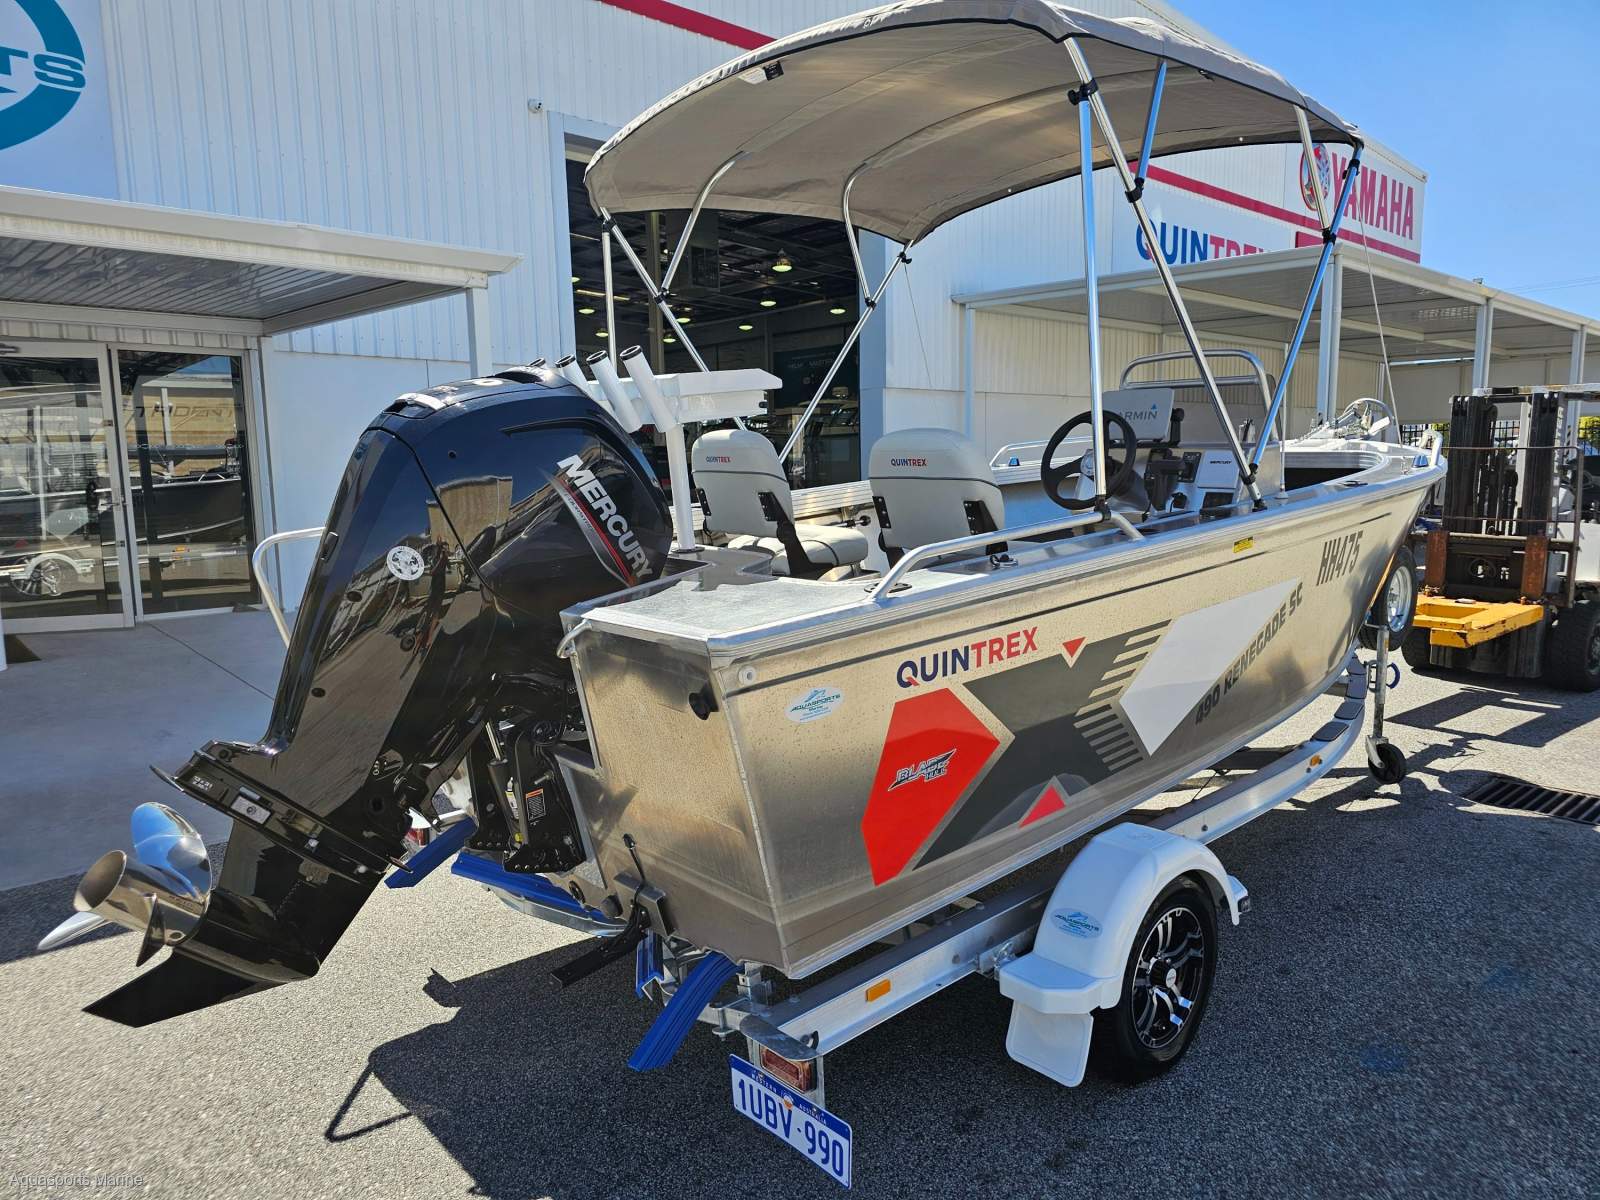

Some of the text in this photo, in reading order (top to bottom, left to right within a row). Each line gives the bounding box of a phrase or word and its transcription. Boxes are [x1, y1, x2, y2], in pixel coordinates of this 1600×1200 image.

[1332, 152, 1413, 240] YAMAHA
[890, 458, 927, 467] QUINTREX
[557, 454, 653, 578] MERCURY
[1316, 530, 1364, 586] HH475
[896, 626, 1038, 688] QUINTREX
[1195, 581, 1303, 725] 490 RENEGADE SC
